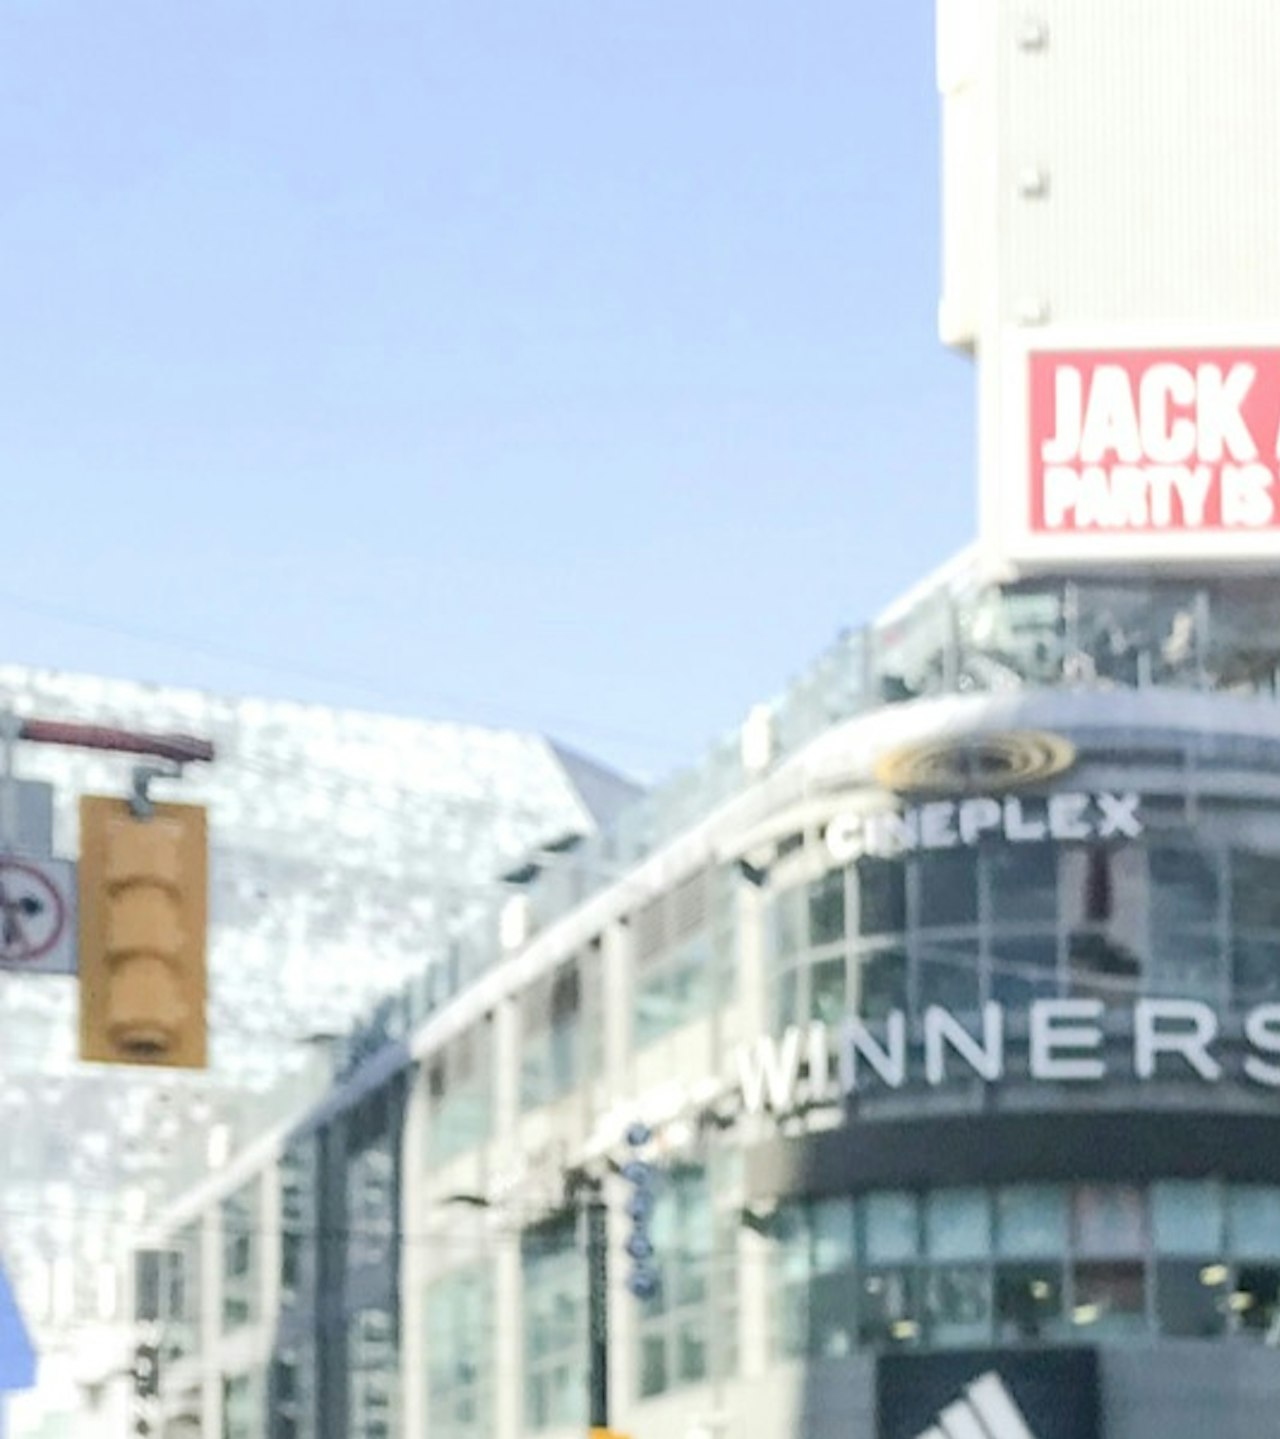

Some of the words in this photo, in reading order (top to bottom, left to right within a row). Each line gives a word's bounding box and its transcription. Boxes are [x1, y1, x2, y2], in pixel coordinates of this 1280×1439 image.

[1041, 362, 1259, 464] JACK
[1042, 460, 1213, 528] PARTY
[1220, 460, 1275, 526] IS
[825, 793, 1143, 858] CINEPLEX
